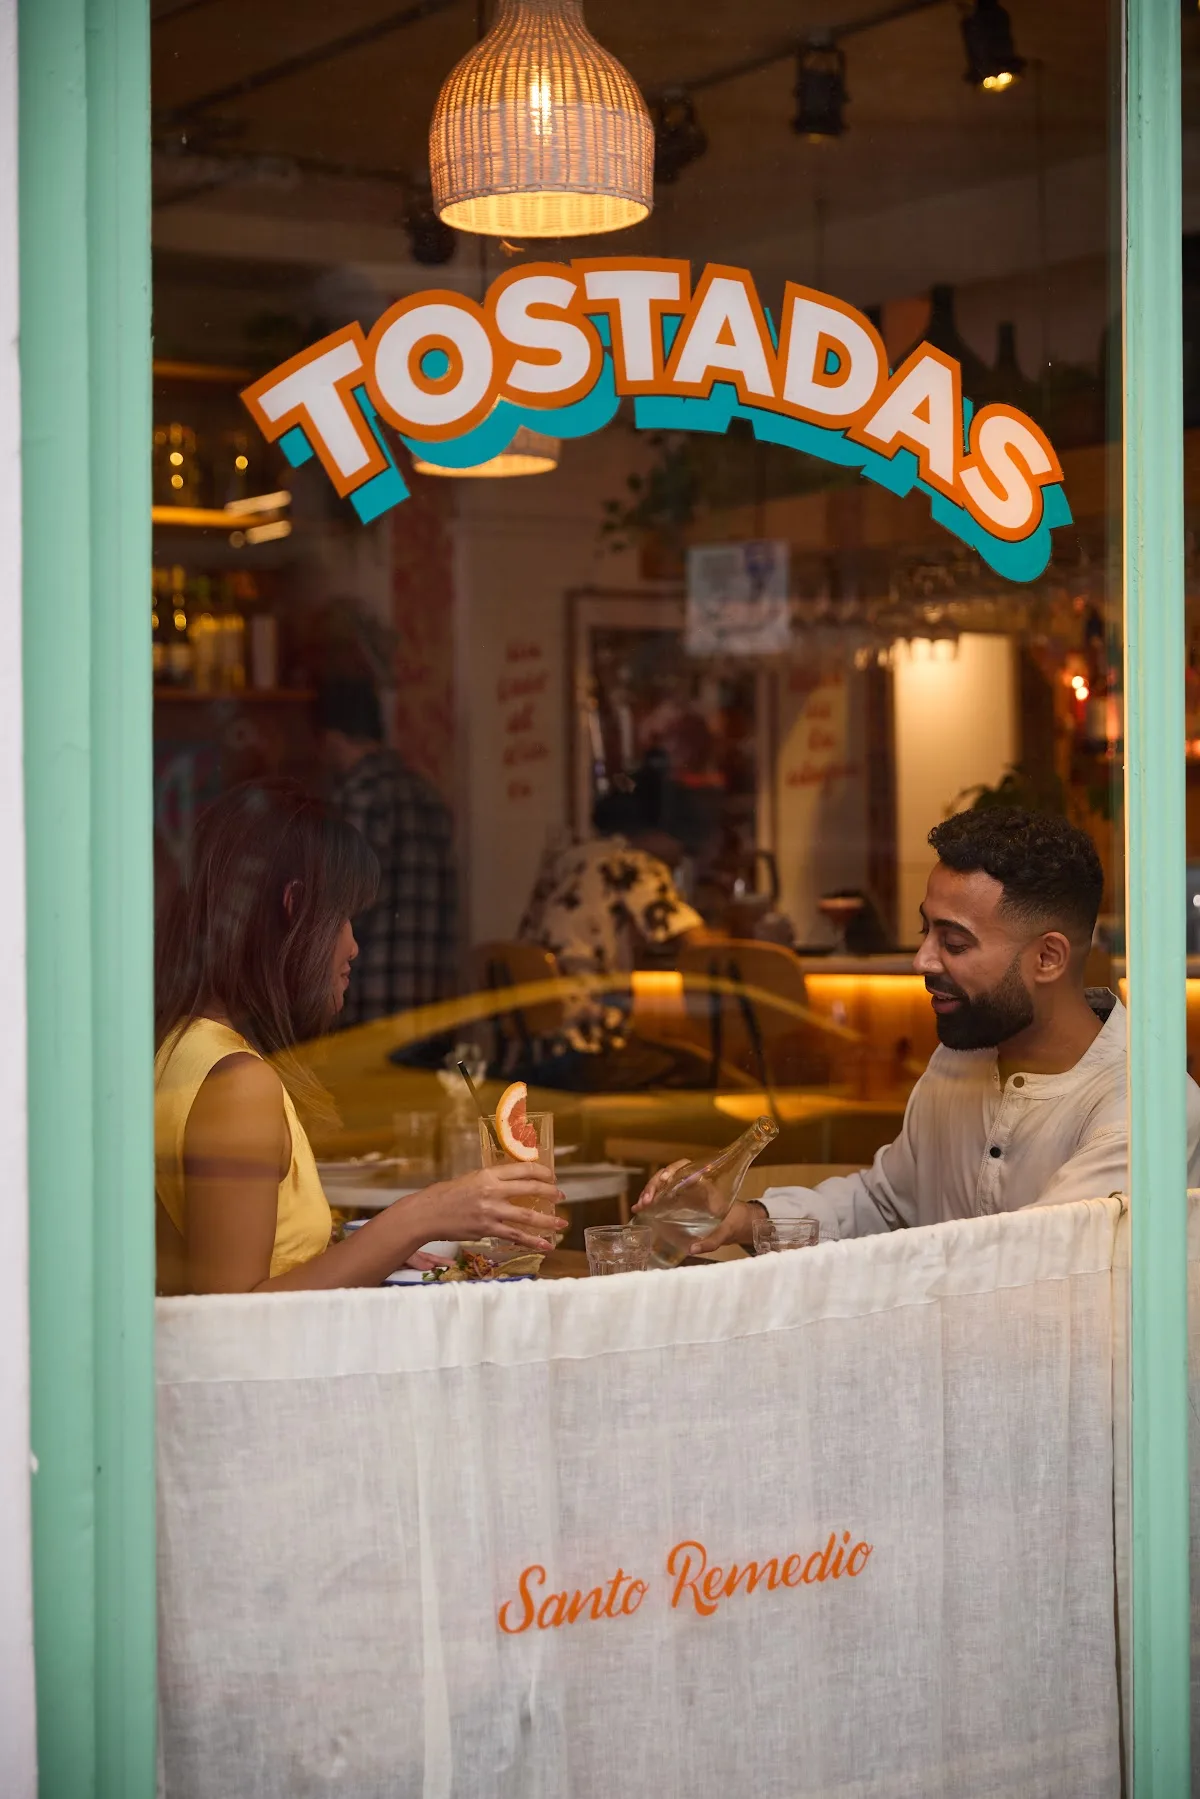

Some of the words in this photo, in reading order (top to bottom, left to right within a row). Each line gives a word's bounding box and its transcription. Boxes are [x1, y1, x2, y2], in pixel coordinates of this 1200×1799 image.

[241, 257, 1067, 544] TOSTADAS
[499, 1564, 649, 1634] Santo
[666, 1530, 873, 1616] Remedio
